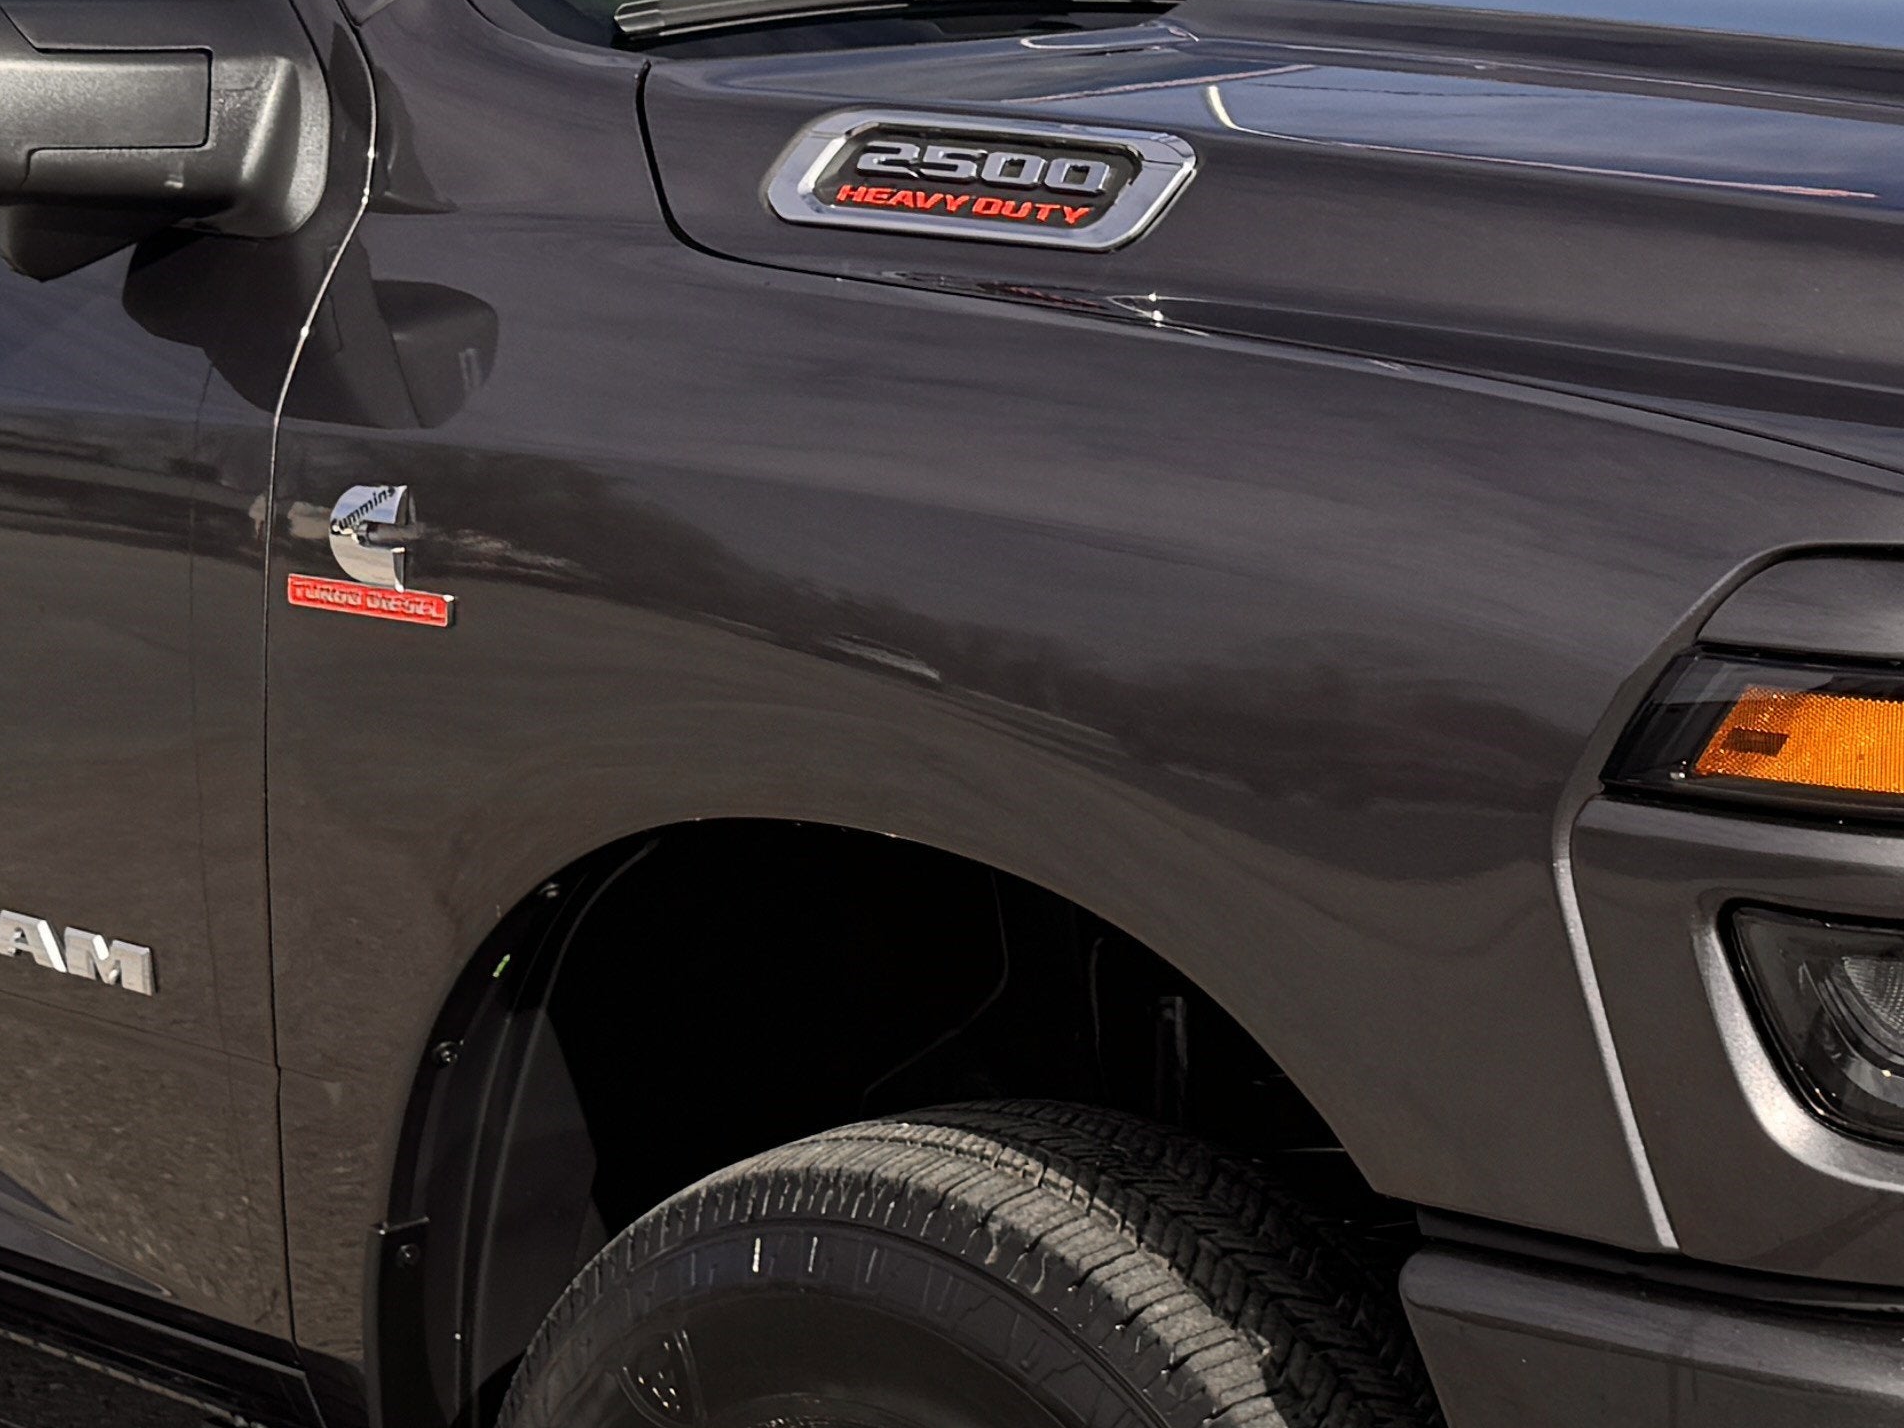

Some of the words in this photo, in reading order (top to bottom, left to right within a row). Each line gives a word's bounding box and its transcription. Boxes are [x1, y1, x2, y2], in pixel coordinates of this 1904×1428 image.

[854, 139, 1113, 196] 2500
[836, 182, 974, 214] HEAVY
[970, 193, 1092, 226] DUTY
[330, 484, 397, 533] Cummins
[292, 580, 362, 608] TURBO
[365, 590, 444, 620] DIESEL
